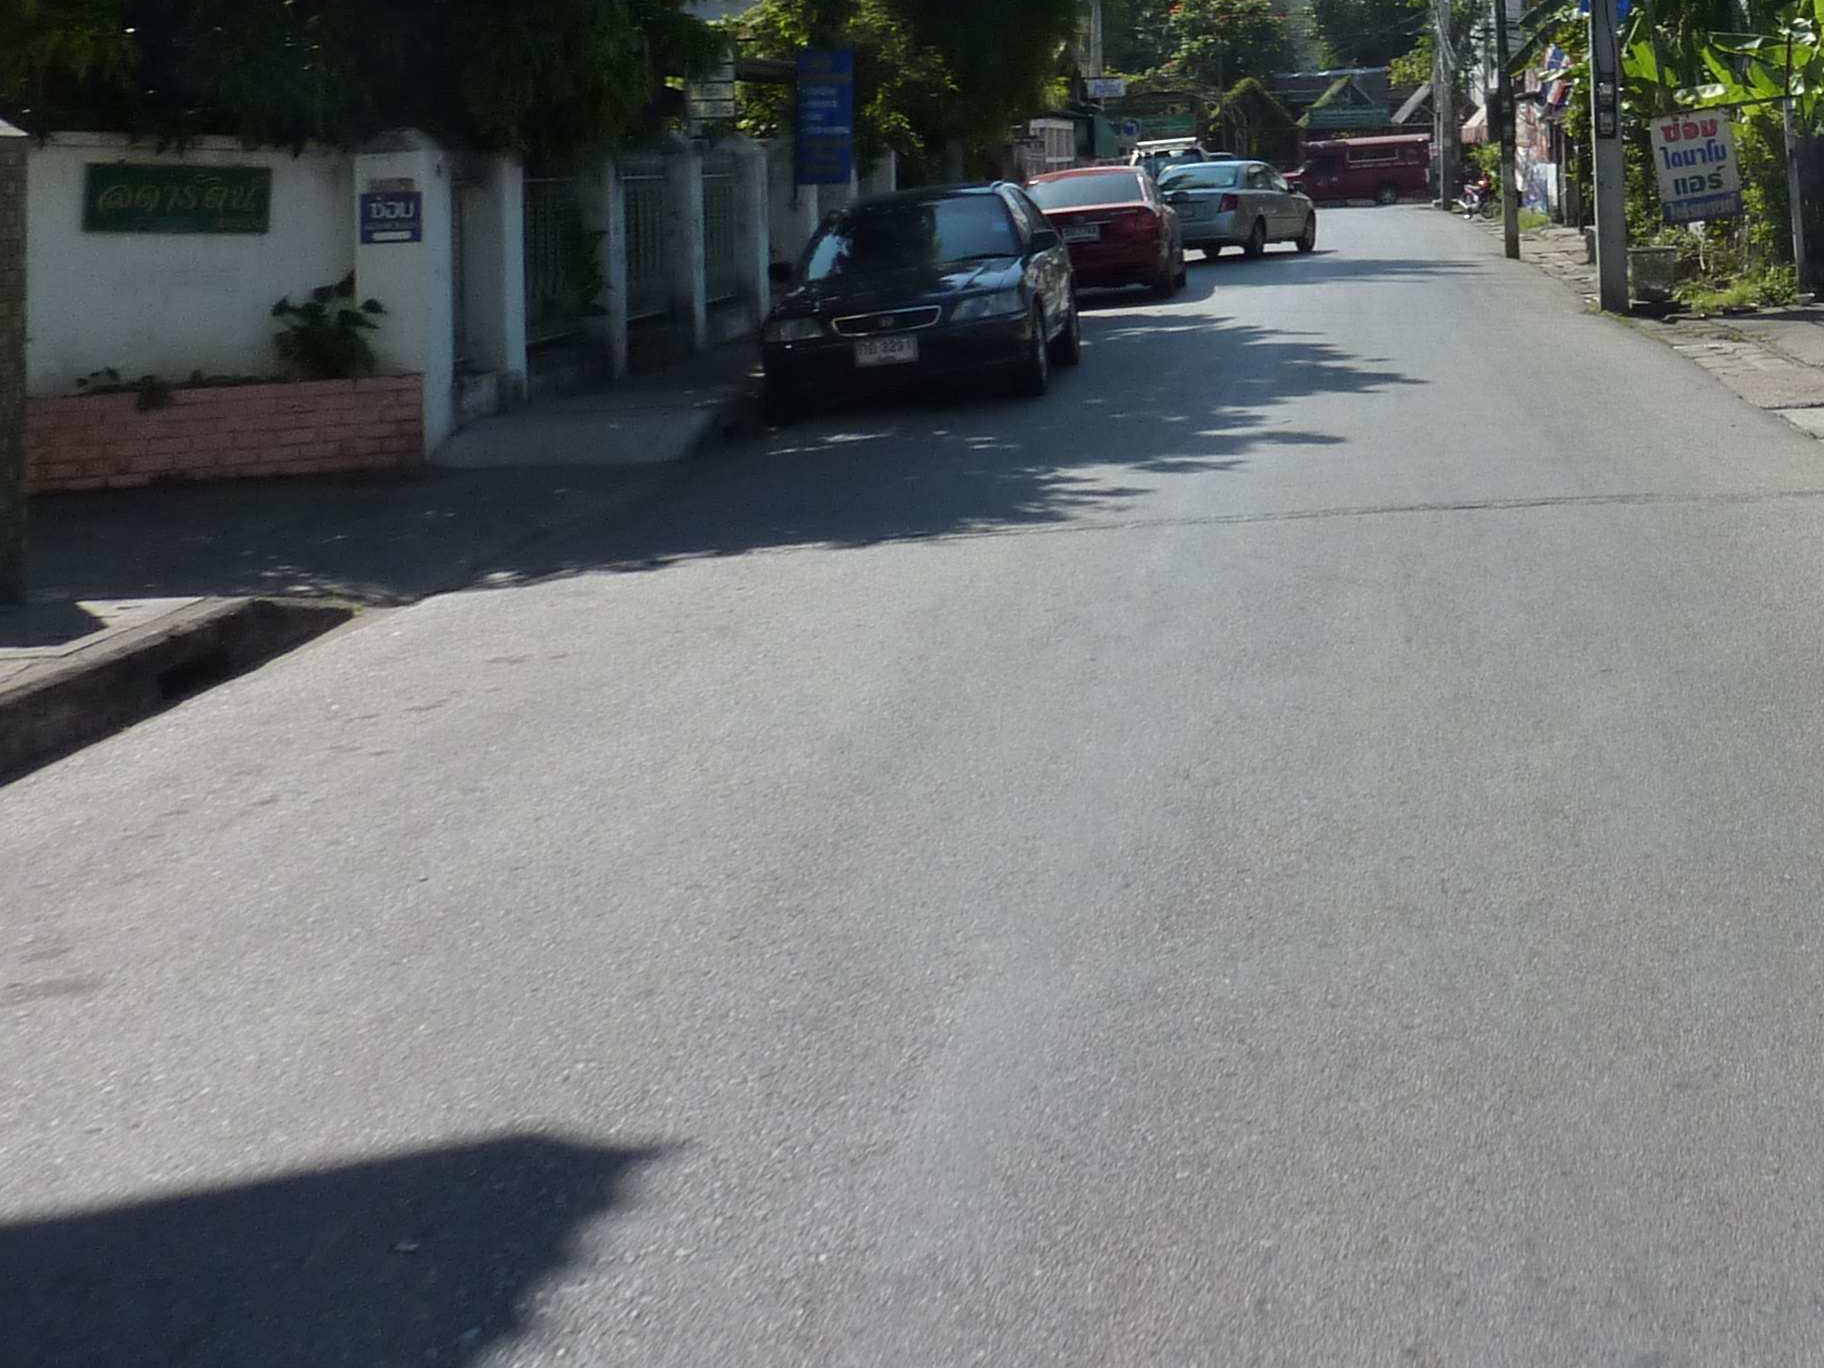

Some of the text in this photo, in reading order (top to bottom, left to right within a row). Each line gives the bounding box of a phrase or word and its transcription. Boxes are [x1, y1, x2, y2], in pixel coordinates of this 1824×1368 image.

[1660, 115, 1718, 143] ซ่อม
[1659, 138, 1727, 170] ไดนาโม
[1673, 165, 1726, 196] แอร์
